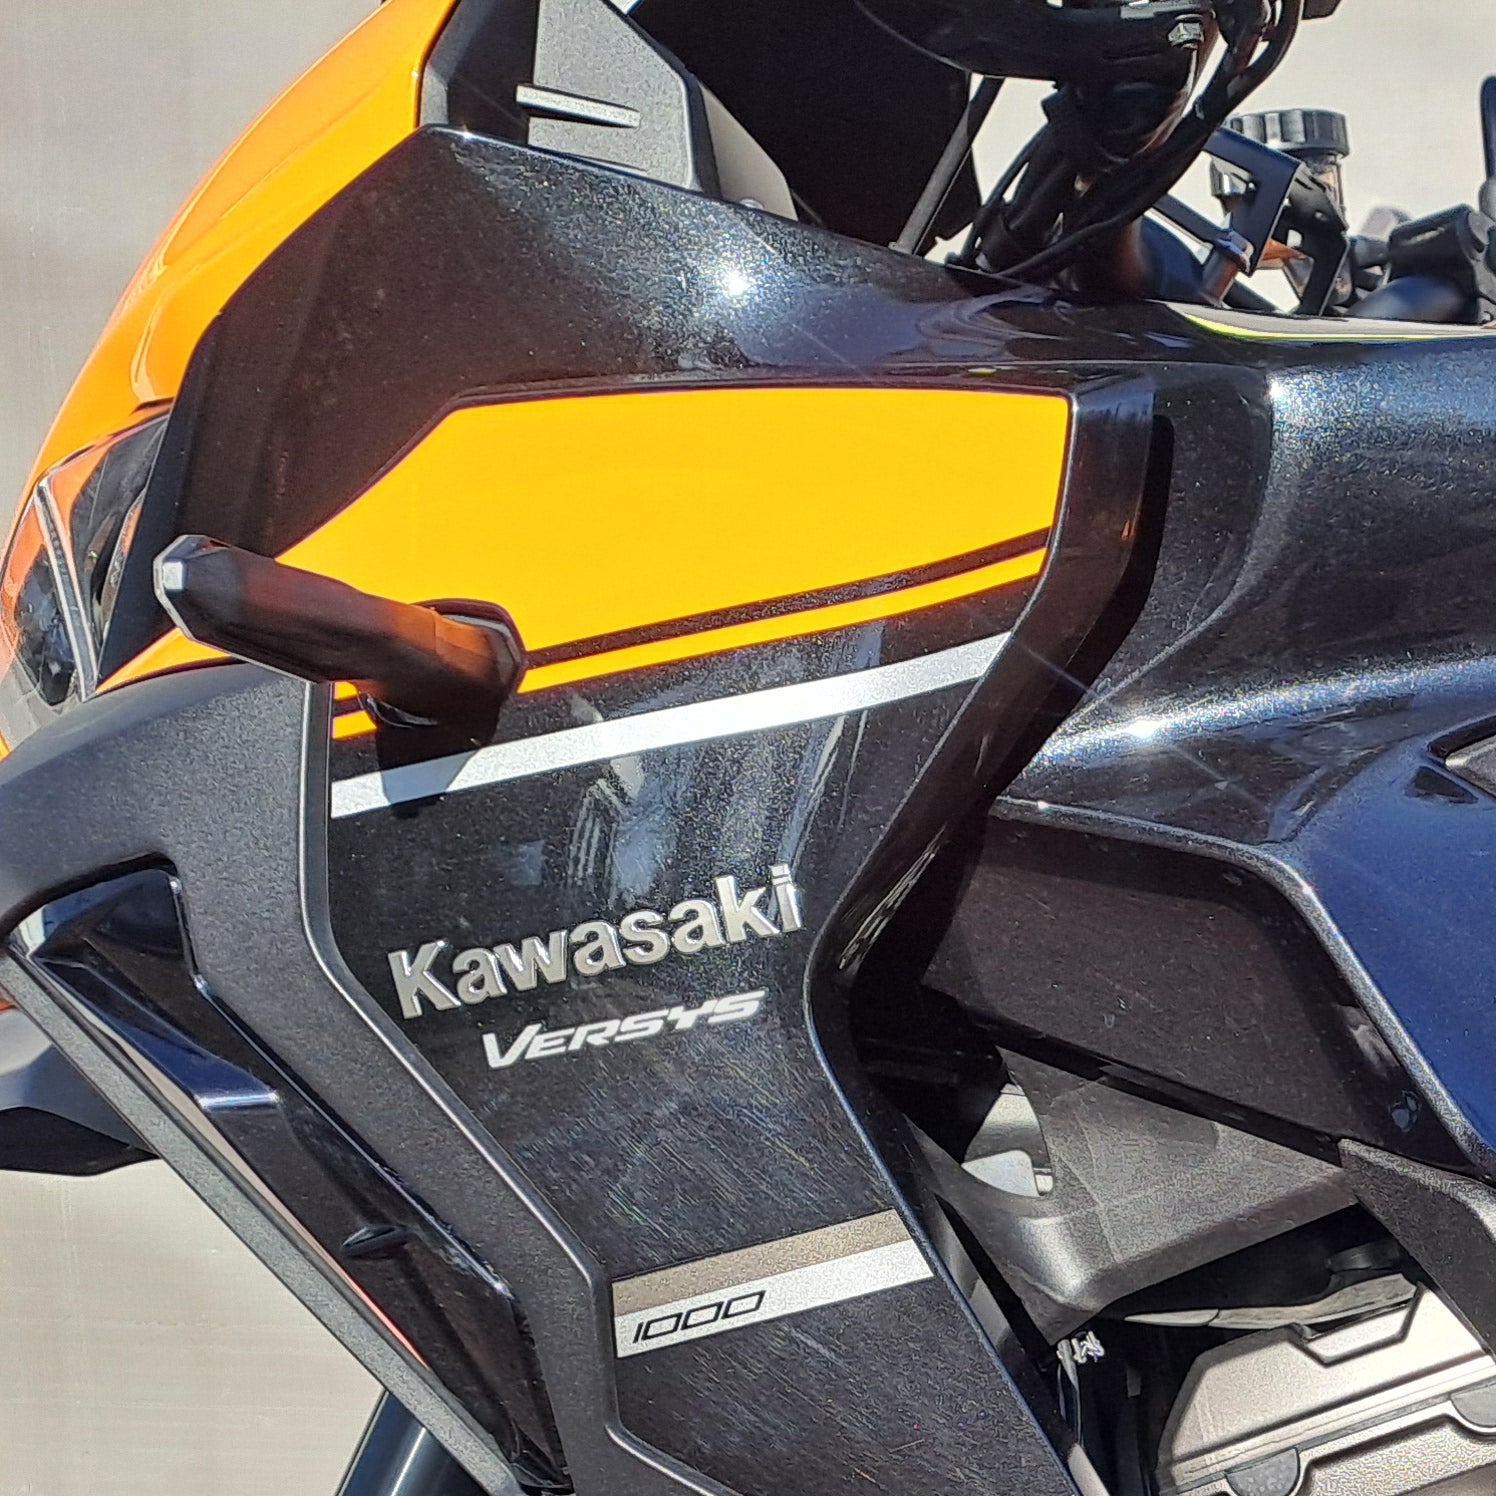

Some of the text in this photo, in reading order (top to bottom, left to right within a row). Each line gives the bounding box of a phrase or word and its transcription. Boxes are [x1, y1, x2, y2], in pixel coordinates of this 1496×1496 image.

[387, 863, 803, 1019] Kawasaki
[482, 988, 770, 1069] VERSYS
[633, 1290, 766, 1343] 1000
